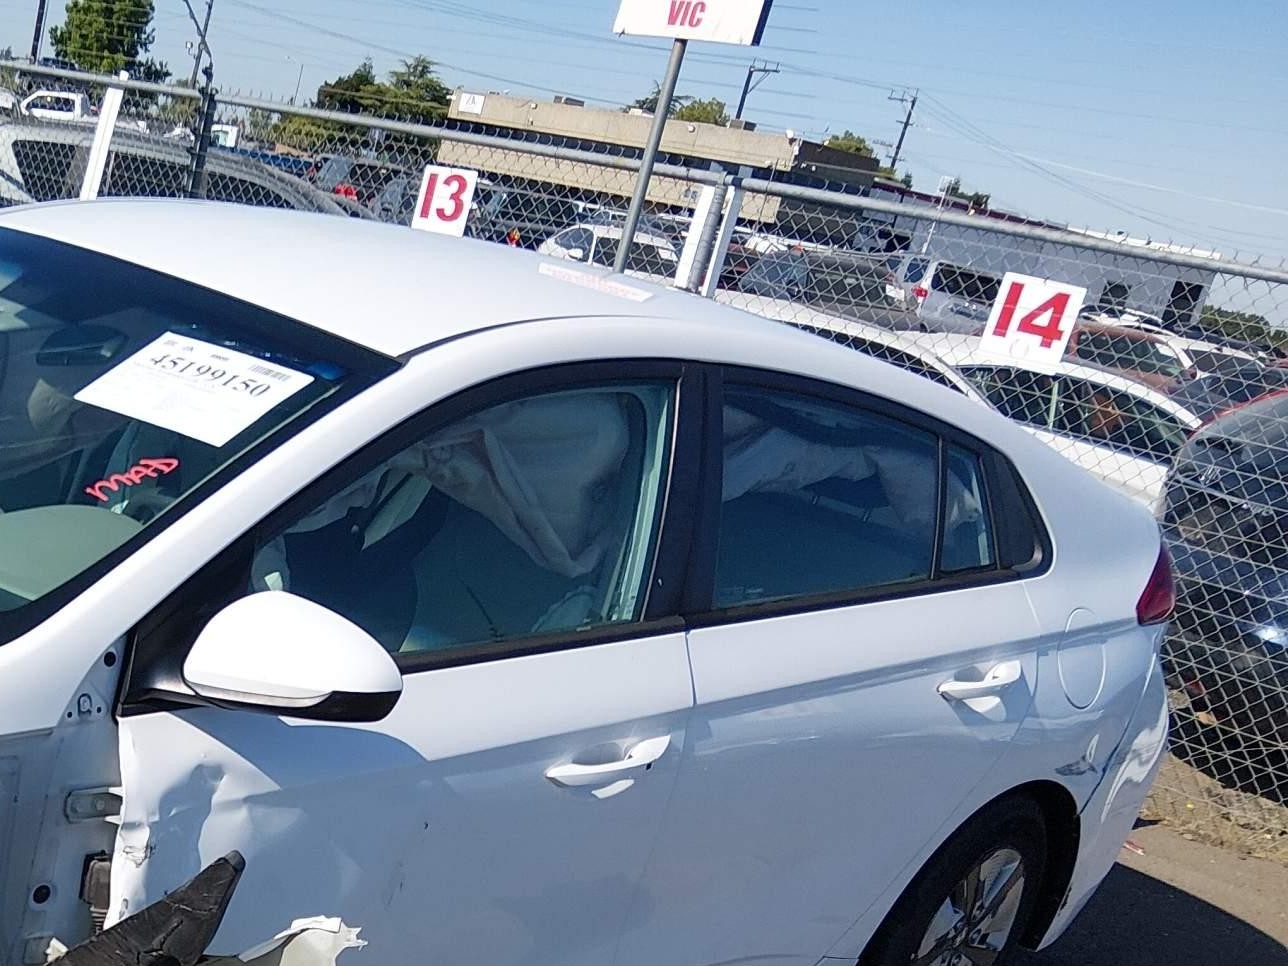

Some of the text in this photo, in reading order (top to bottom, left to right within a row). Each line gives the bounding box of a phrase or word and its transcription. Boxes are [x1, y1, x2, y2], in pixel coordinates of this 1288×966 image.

[667, 0, 707, 28] VIC
[419, 172, 468, 222] 13
[992, 281, 1072, 349] 14
[149, 353, 272, 398] 45199150
